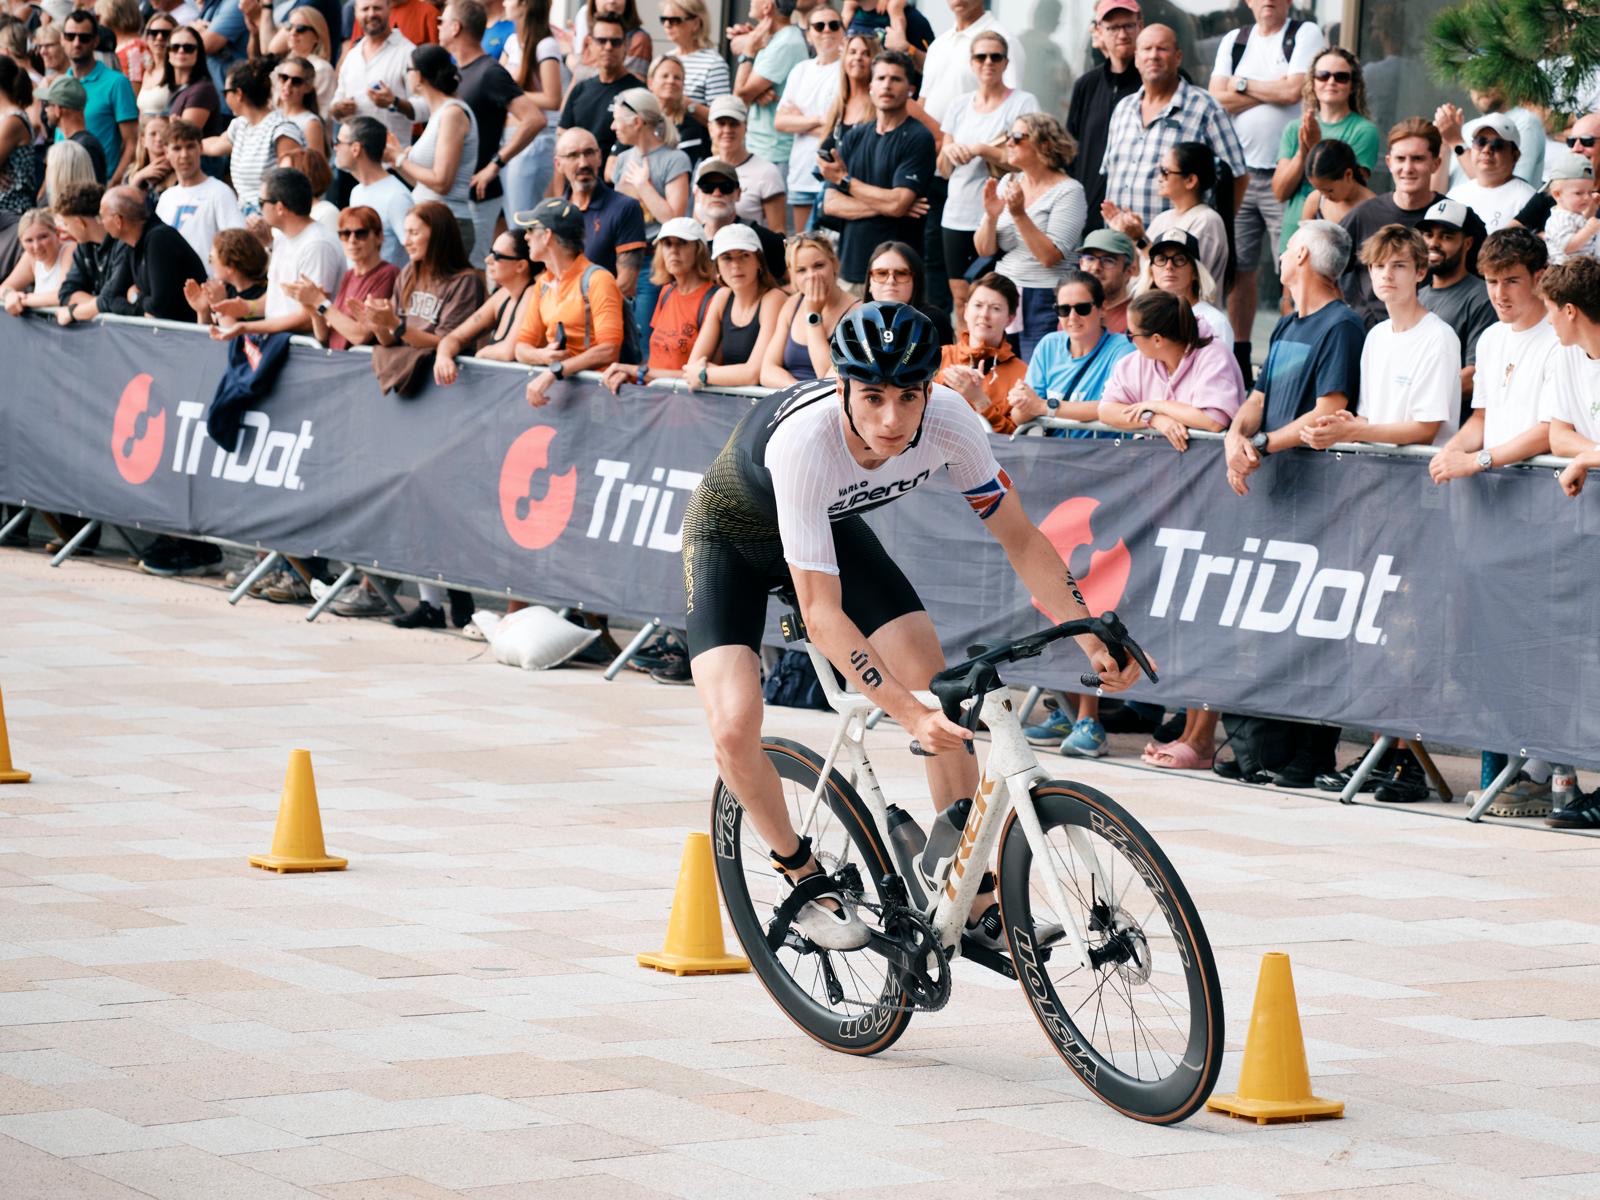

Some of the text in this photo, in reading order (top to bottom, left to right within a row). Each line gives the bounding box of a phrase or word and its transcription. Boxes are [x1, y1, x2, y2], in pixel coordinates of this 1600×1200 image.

[883, 330, 894, 343] 9
[586, 458, 704, 553] TriD
[838, 480, 869, 497] VARLO
[1149, 527, 1402, 645] TriDot
[862, 666, 883, 688] 9
[715, 784, 740, 860] Vis
[1014, 926, 1101, 1088] Vision
